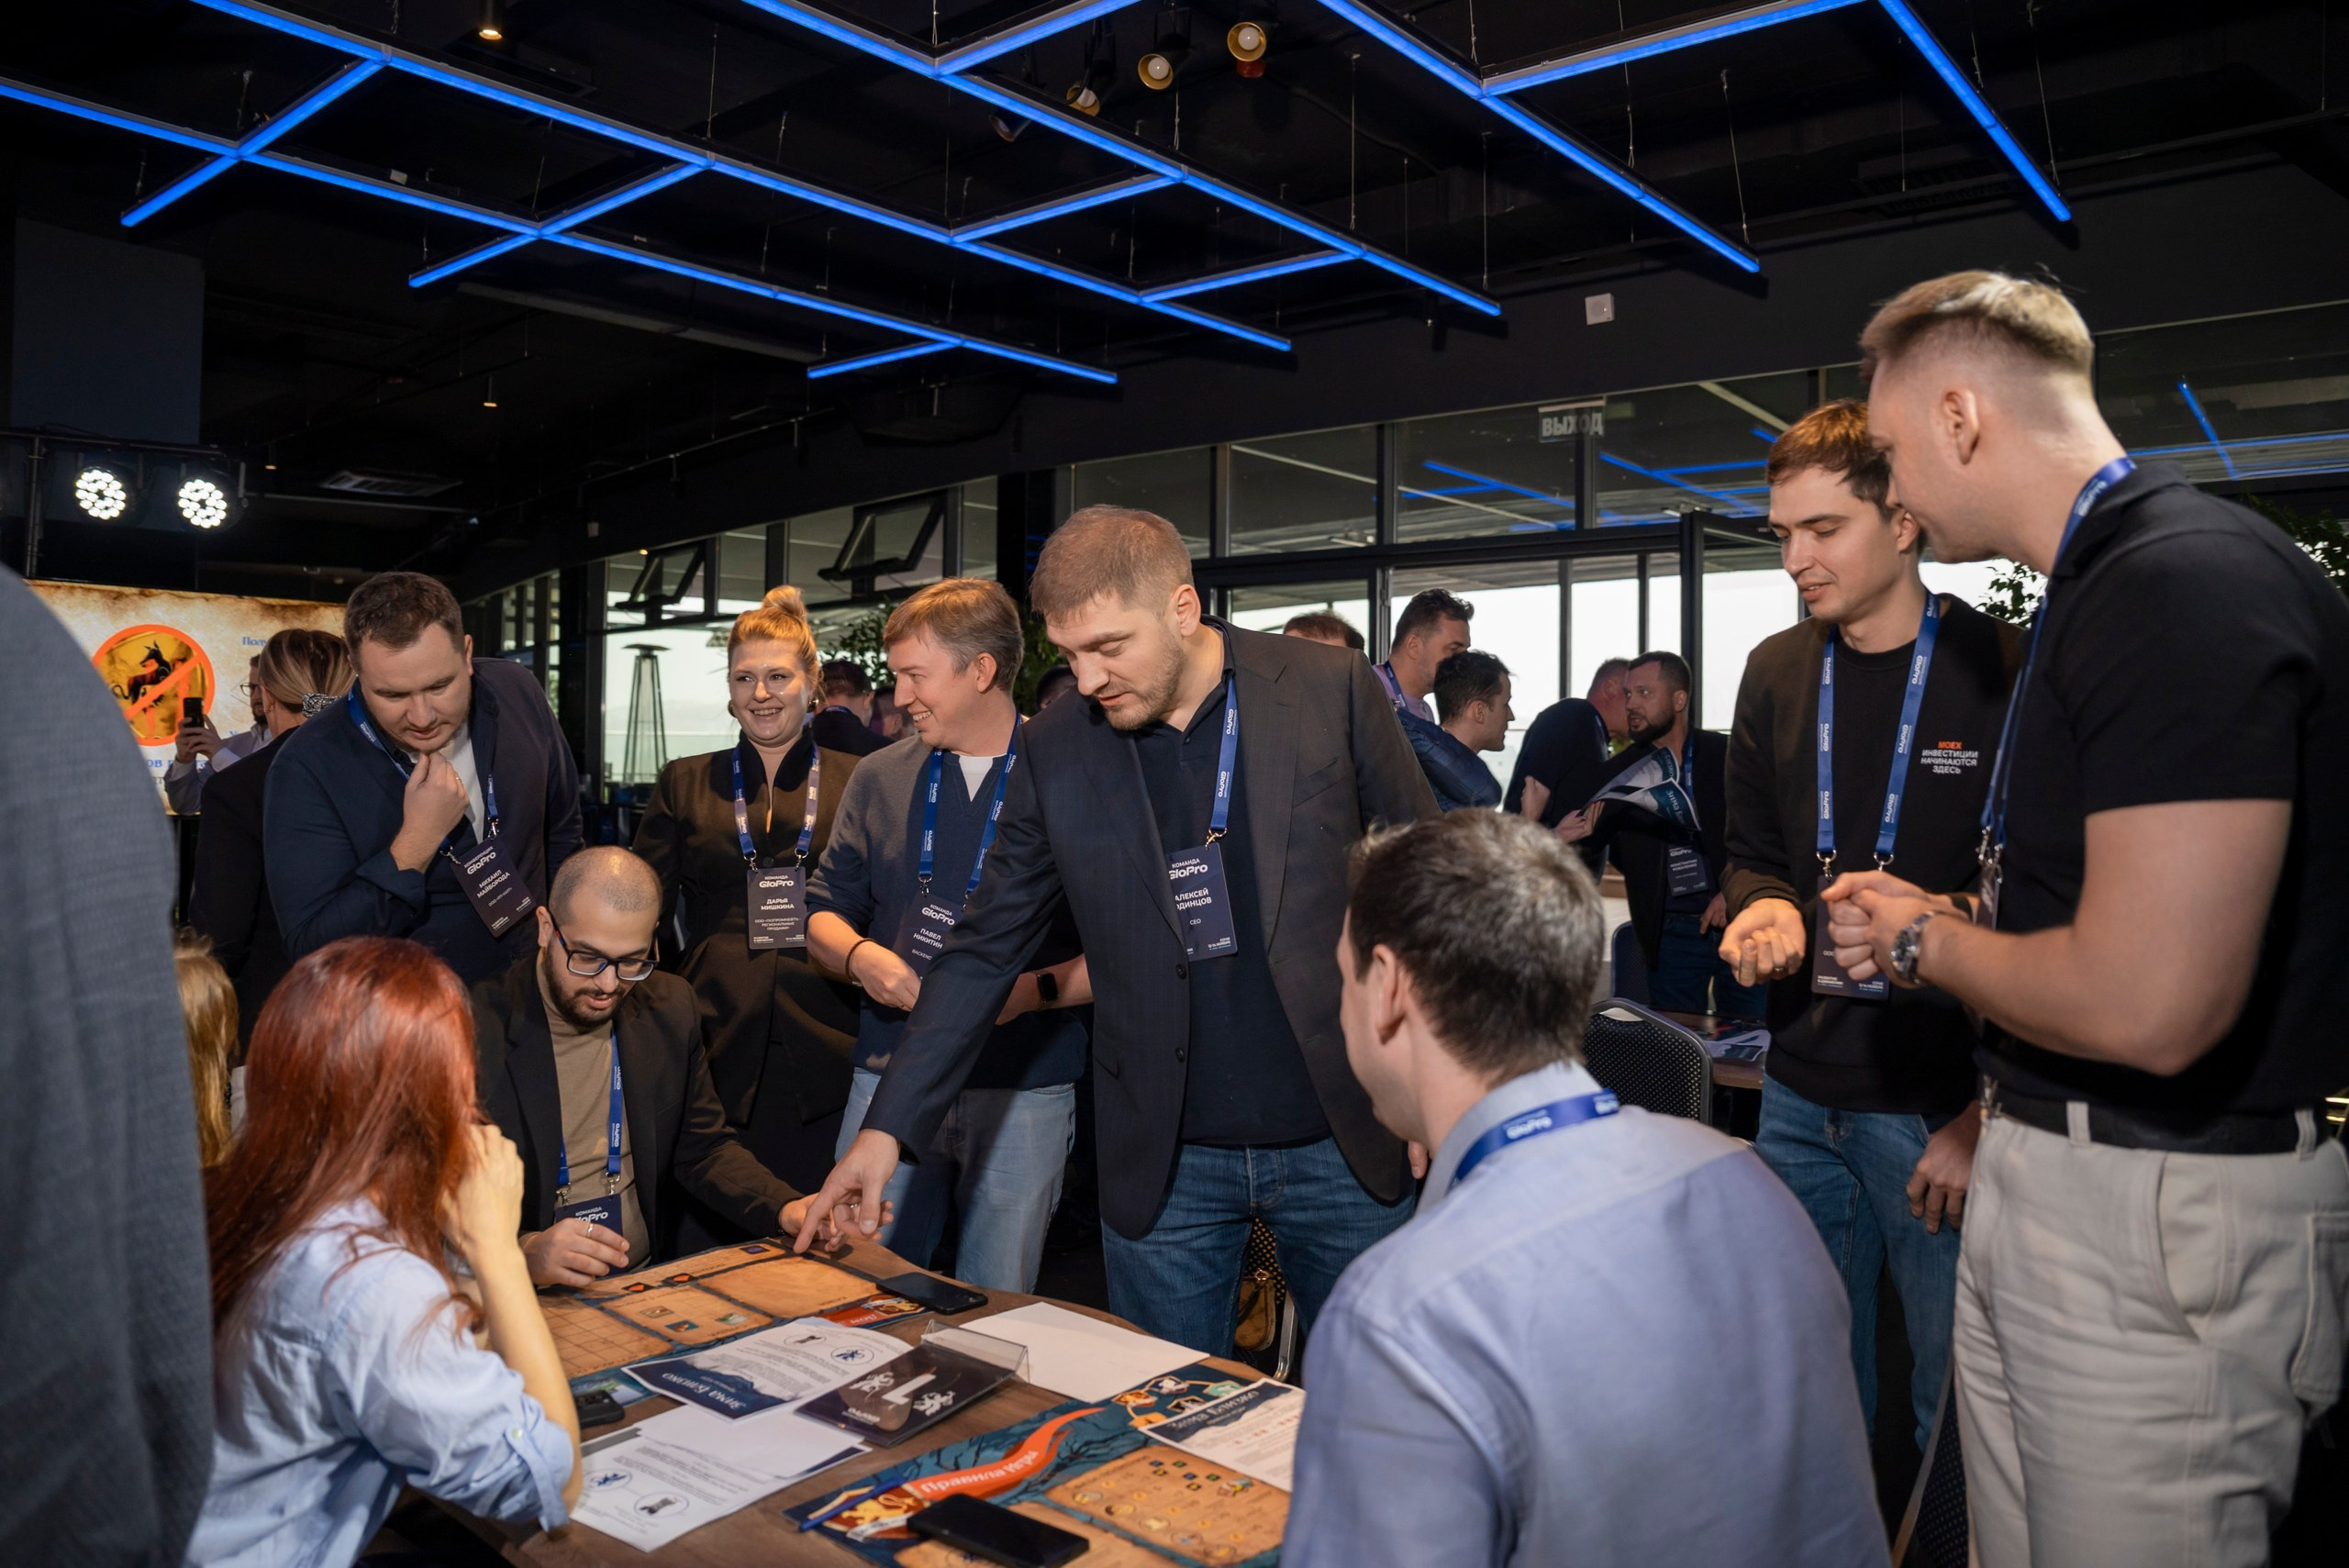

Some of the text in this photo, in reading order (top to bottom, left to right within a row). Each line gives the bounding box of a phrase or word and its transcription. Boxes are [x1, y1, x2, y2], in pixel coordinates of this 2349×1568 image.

[1542, 412, 1605, 438] ВЫХОД
[1911, 654, 1924, 685] GloPro
[1226, 708, 1234, 735] GloPro
[1898, 723, 1909, 754] GloPro
[1937, 740, 1963, 750] MOEX
[1920, 757, 1977, 767] НАЧИНАЮТСЯ
[1921, 749, 1979, 759] ИНВЕСТИЦИИ
[1932, 765, 1962, 774] ЗДЕСЬ
[1218, 770, 1227, 798] GloPro
[1884, 793, 1895, 823] GloPro
[466, 851, 497, 876] GloPro
[1172, 858, 1200, 869] КОМАНДА
[476, 872, 511, 899] МАЙБОРОДА
[478, 869, 503, 890] МИХАИЛ
[759, 880, 795, 888] GloPro
[1174, 887, 1209, 902] АЛЕКСЕЙ
[921, 906, 955, 926] GloPro
[930, 904, 952, 917] КОМАНДА
[913, 932, 943, 950] НИКИТИН
[919, 928, 941, 941] ПАВЕЛ
[1506, 1116, 1553, 1140] GloPro
[575, 1207, 602, 1217] КОМАНДА
[662, 1372, 711, 1395] Близко
[881, 1373, 937, 1407] 1
[707, 1389, 747, 1410] Зима
[920, 1468, 1008, 1494] Правила
[1004, 1450, 1040, 1474] Игры
